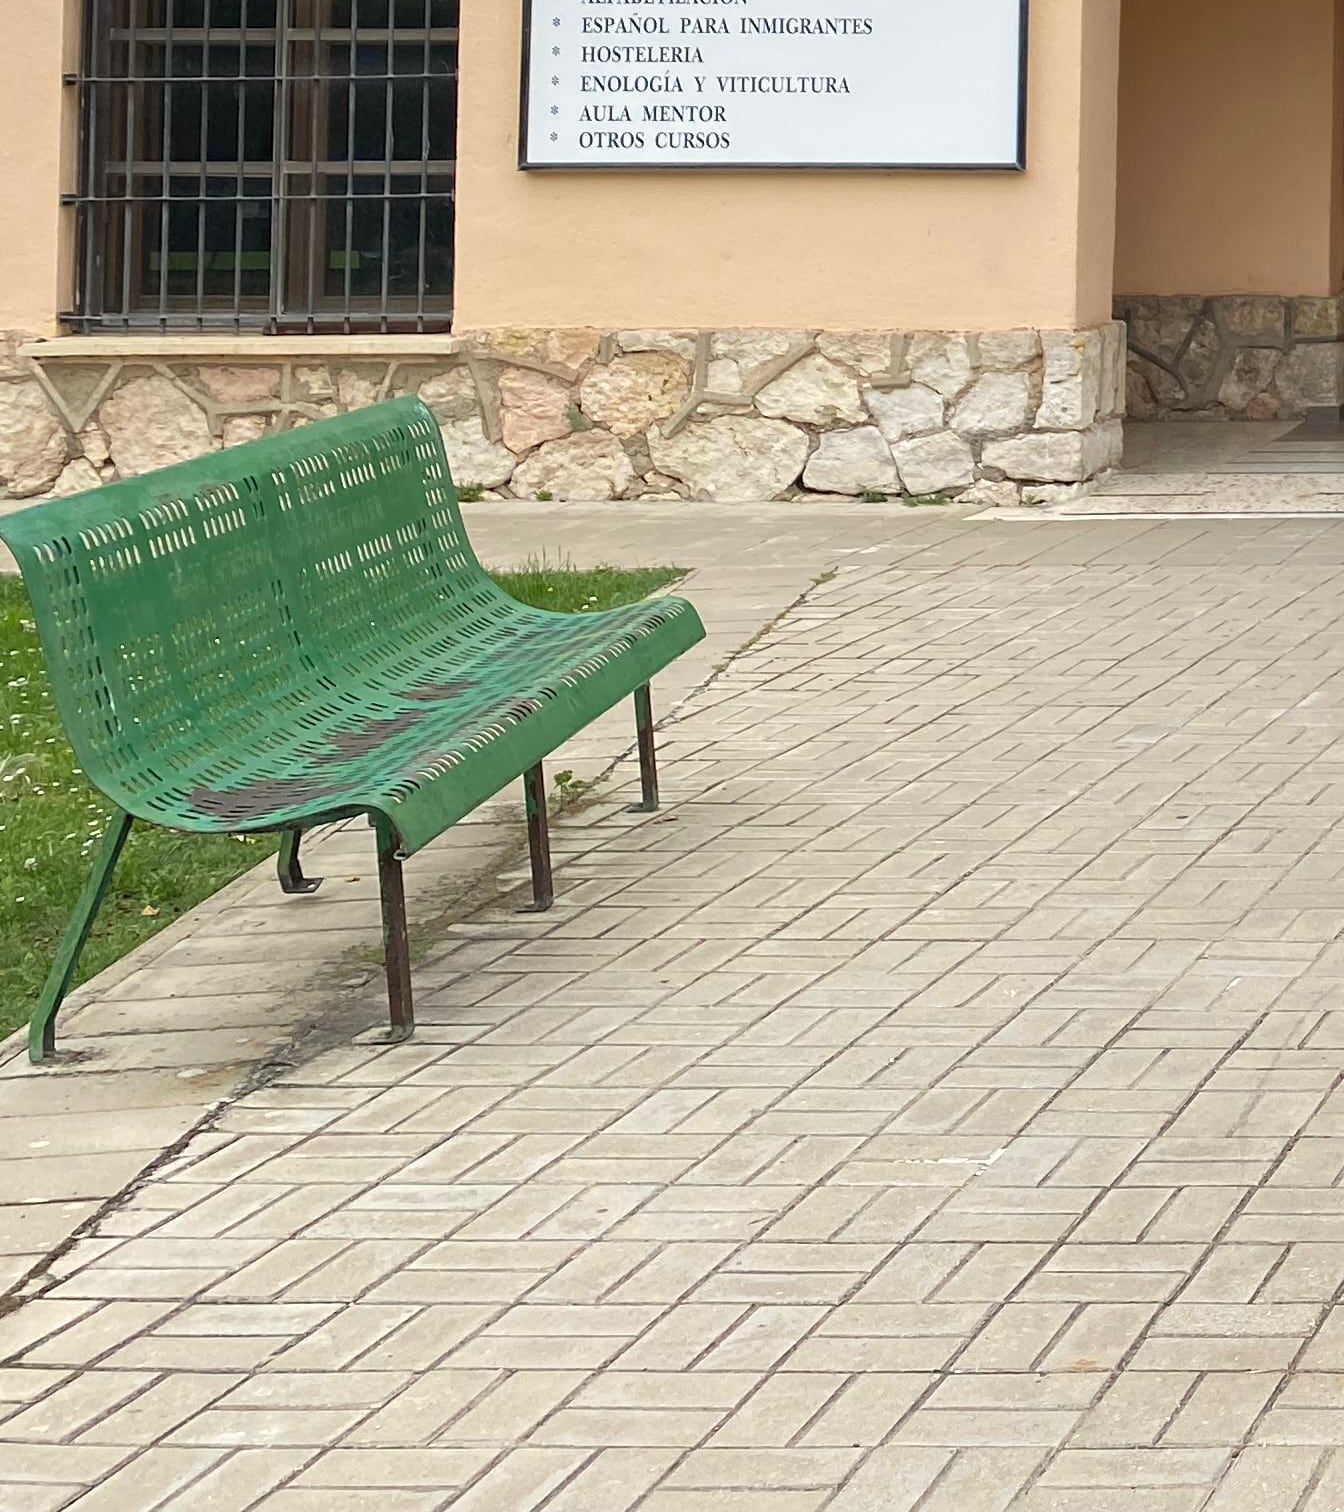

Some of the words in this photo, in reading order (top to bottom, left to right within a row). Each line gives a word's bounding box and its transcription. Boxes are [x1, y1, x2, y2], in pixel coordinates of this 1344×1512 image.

[582, 13, 669, 33] ESPAÑOL
[680, 18, 730, 33] PARA
[741, 18, 872, 34] INMIGRANTES
[582, 46, 704, 62] HOSTELERIA
[581, 70, 683, 92] ENOLOGÍA
[695, 76, 706, 92] Y
[717, 77, 850, 93] VITICULTURA
[579, 105, 631, 121] AULA
[642, 106, 726, 122] MENTOR
[580, 132, 644, 148] OTROS
[656, 132, 729, 148] CURSOS
